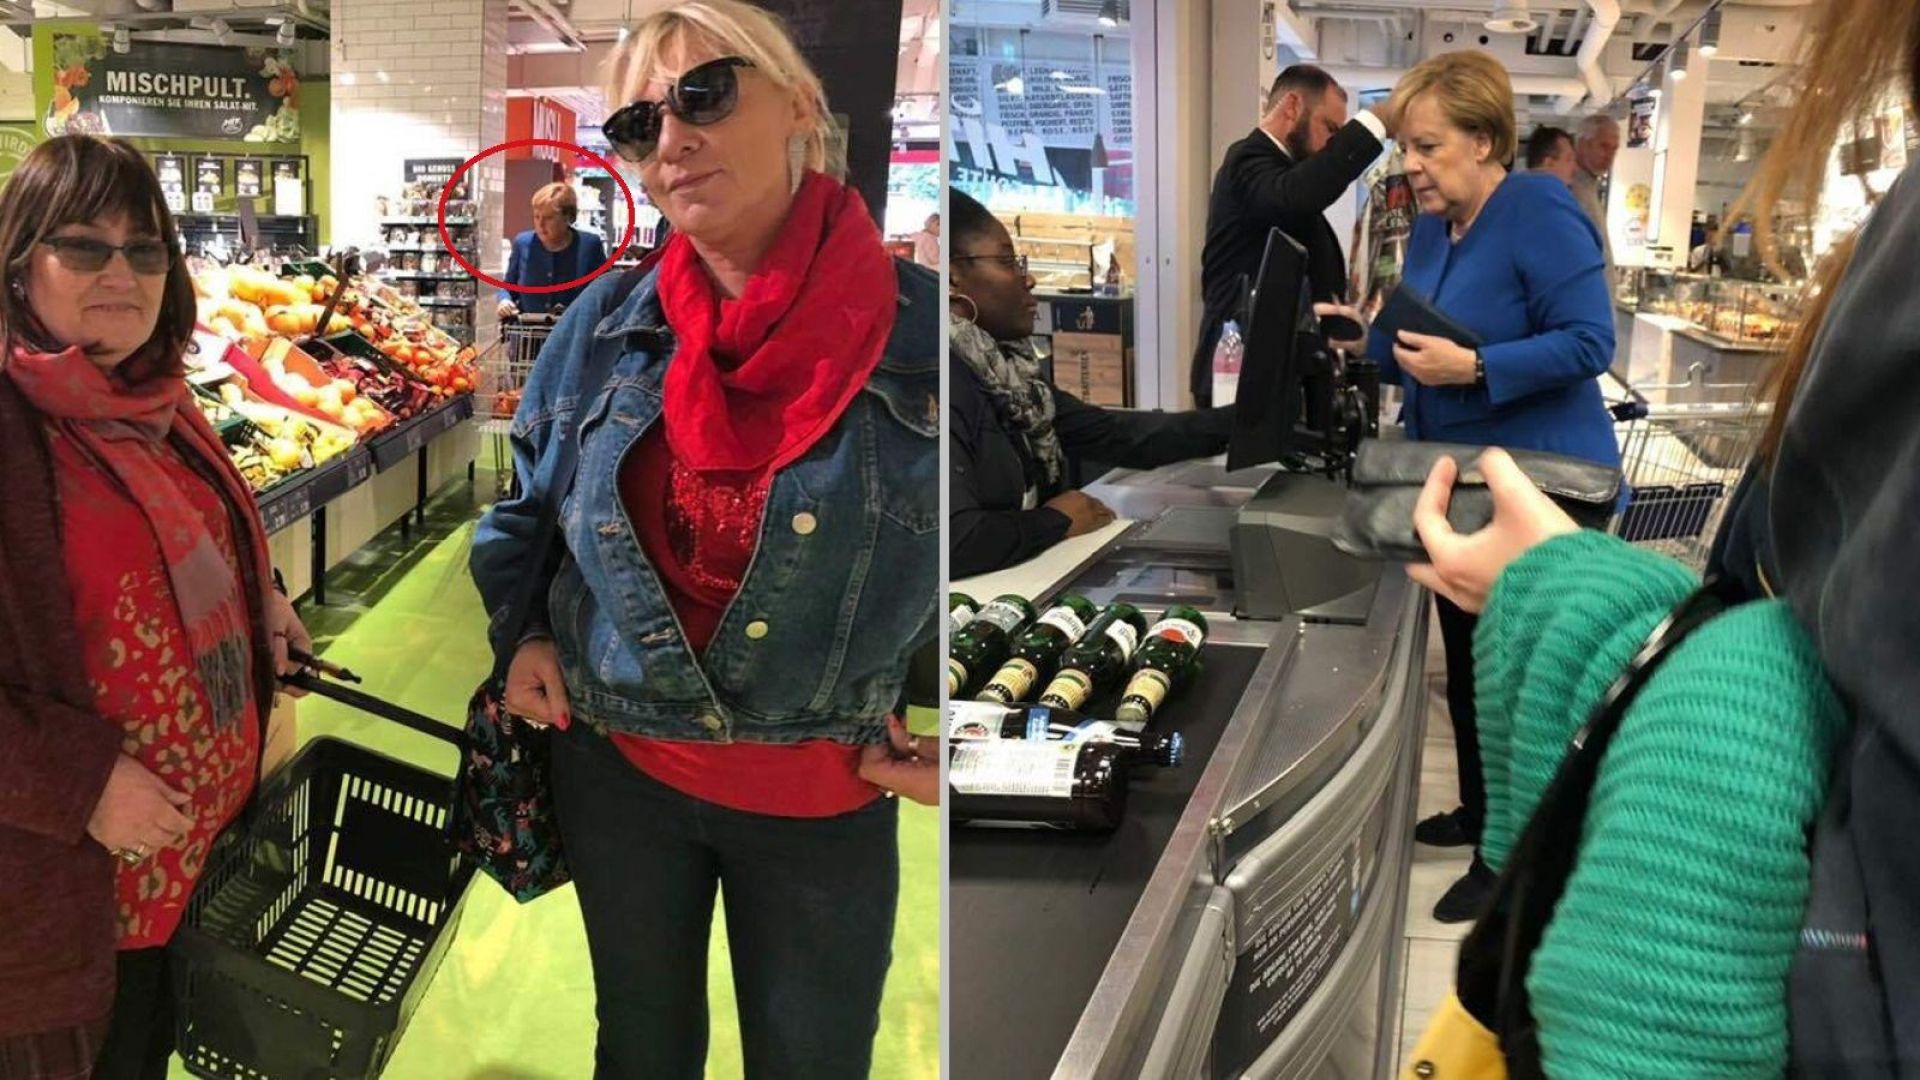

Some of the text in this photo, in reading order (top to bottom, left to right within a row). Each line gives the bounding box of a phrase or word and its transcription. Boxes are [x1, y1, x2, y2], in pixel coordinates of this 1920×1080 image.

[107, 71, 250, 99] MISCHPULT.
[98, 95, 164, 107] KOMPONIEREN
[167, 98, 181, 108] SIE
[185, 99, 211, 110] IHREN
